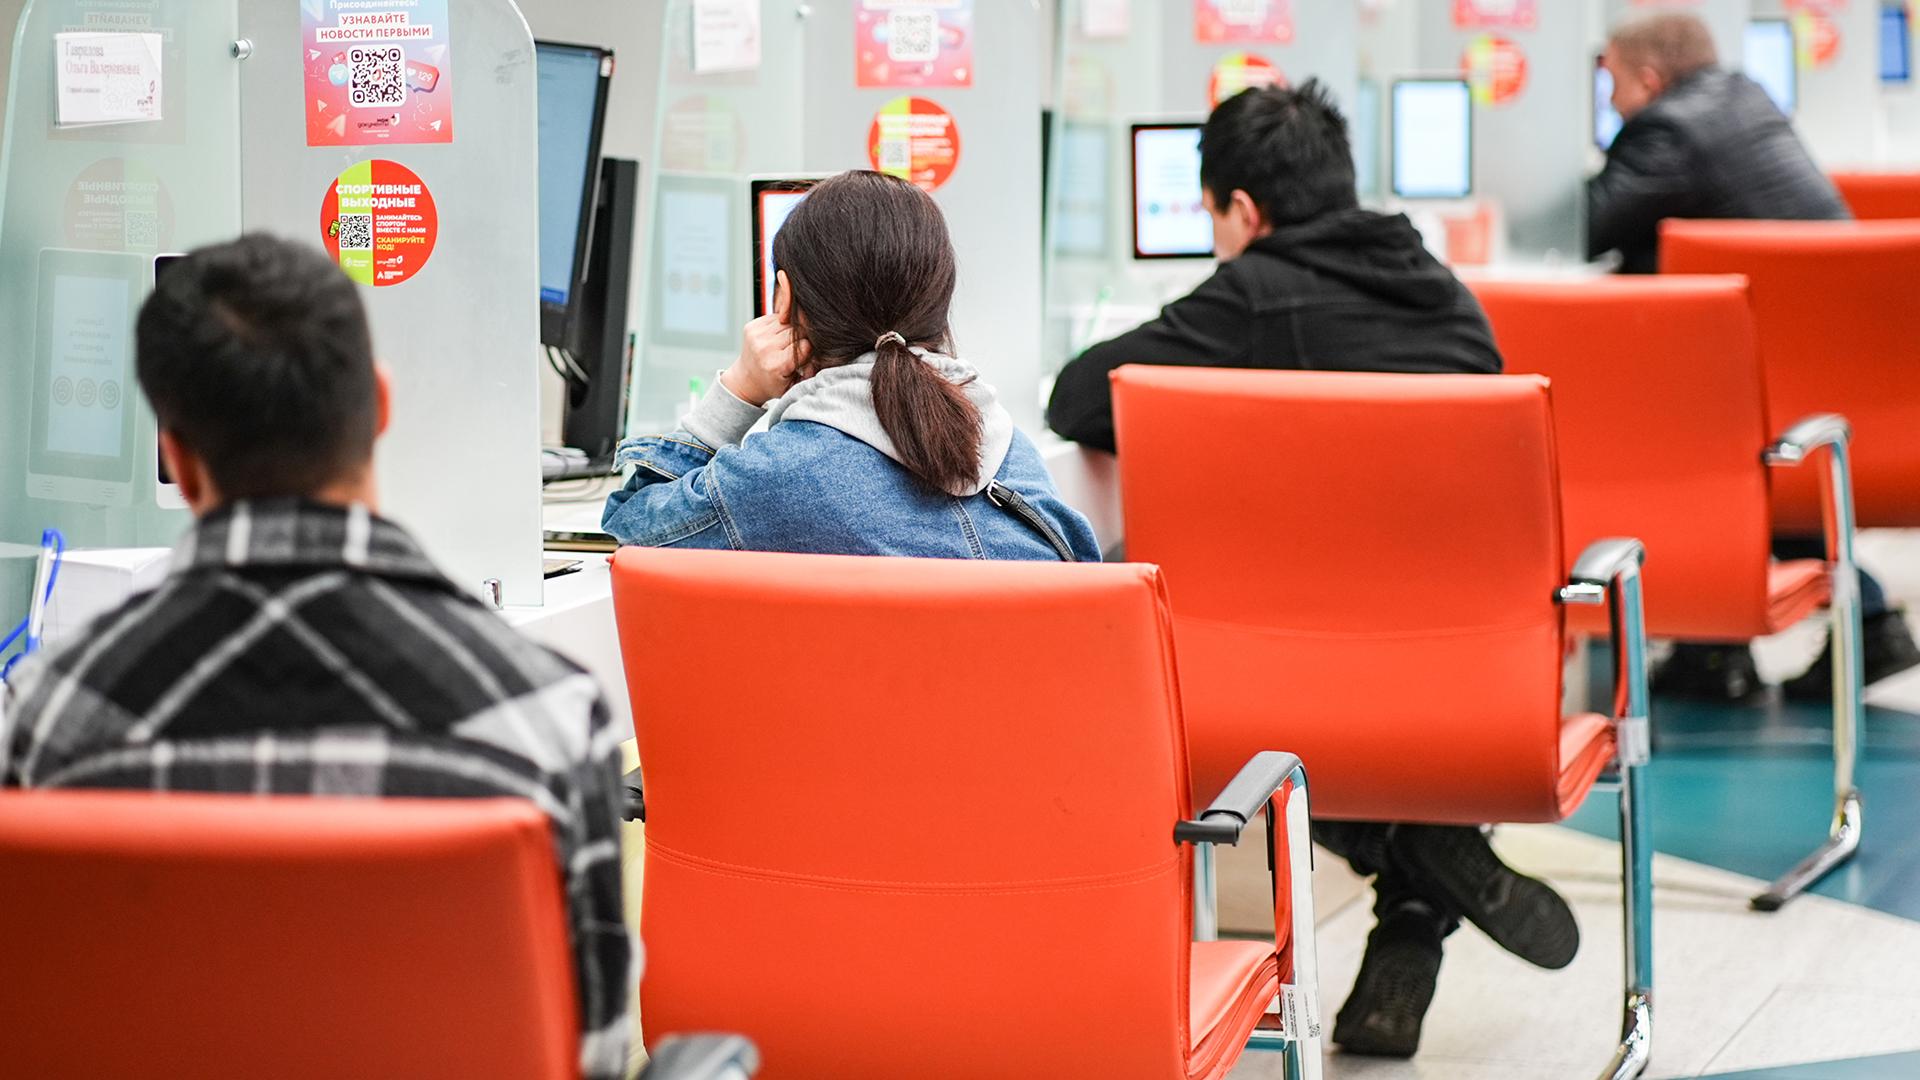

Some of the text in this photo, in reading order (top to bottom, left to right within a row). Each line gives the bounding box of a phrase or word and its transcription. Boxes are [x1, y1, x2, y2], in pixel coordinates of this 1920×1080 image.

[341, 13, 406, 25] УЗНАВАЙТЕ
[320, 27, 430, 39] НОВОСТИ ПЕРВЫМИ
[418, 71, 433, 82] 129
[335, 184, 422, 195] СПОРТИВНЫЕ
[341, 197, 416, 209] ВЫХОДНЫЕ
[376, 236, 425, 244] СКАНИРУЙТЕ
